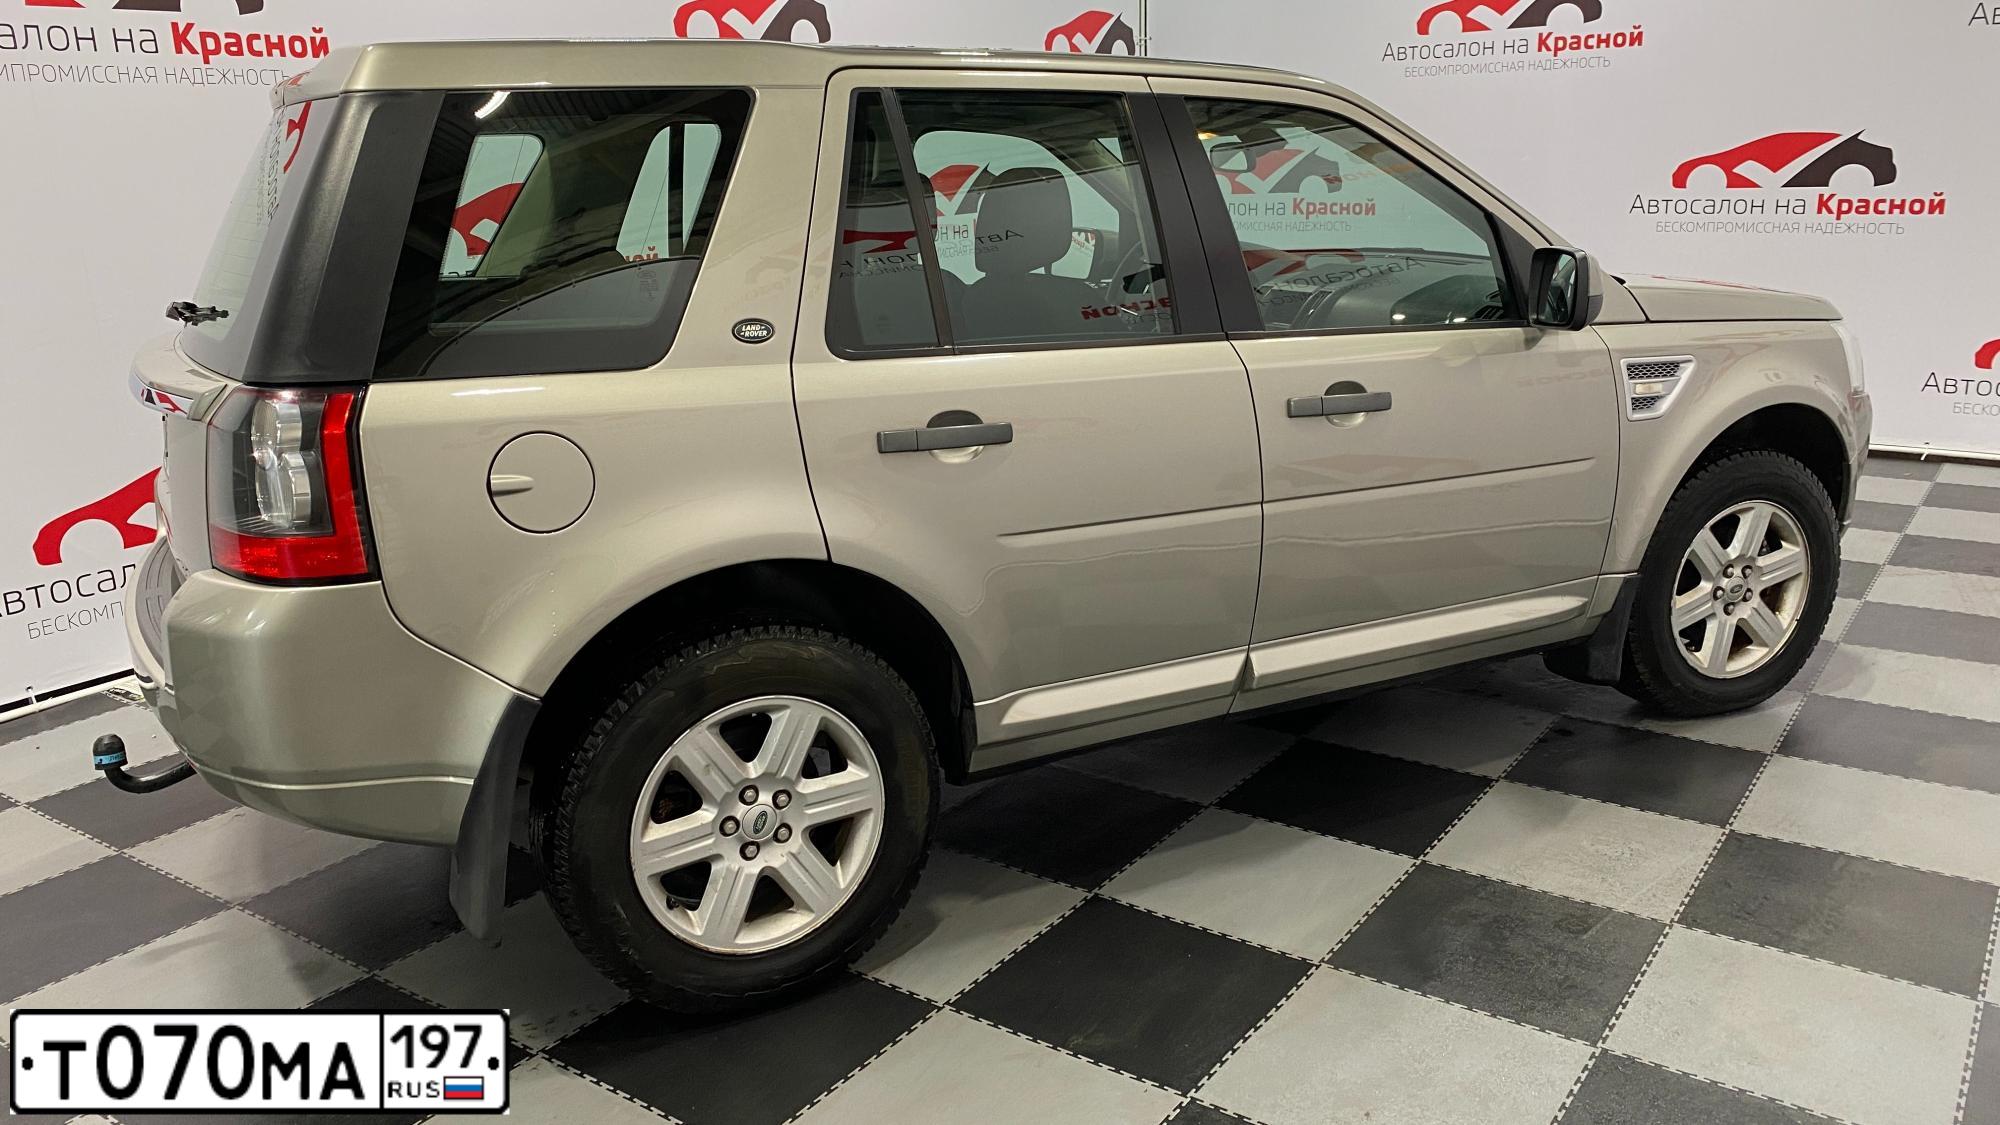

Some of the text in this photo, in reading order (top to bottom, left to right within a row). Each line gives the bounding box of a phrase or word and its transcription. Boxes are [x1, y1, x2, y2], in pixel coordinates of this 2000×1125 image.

[112, 27, 159, 54] на
[171, 21, 330, 64] Красной
[1382, 24, 1644, 62] Автосалон на Красной
[1404, 56, 1612, 79] БЕСКОМПРОМИССНАЯ НАДЕЖНОСТЬ
[1265, 202, 1286, 216] на
[1292, 198, 1376, 219] Красной
[1629, 191, 1947, 221] Автосалон на Красной
[1655, 221, 1906, 235] БЕСКОМПРОМИССНАЯ НАДЕЖНОСТЬ
